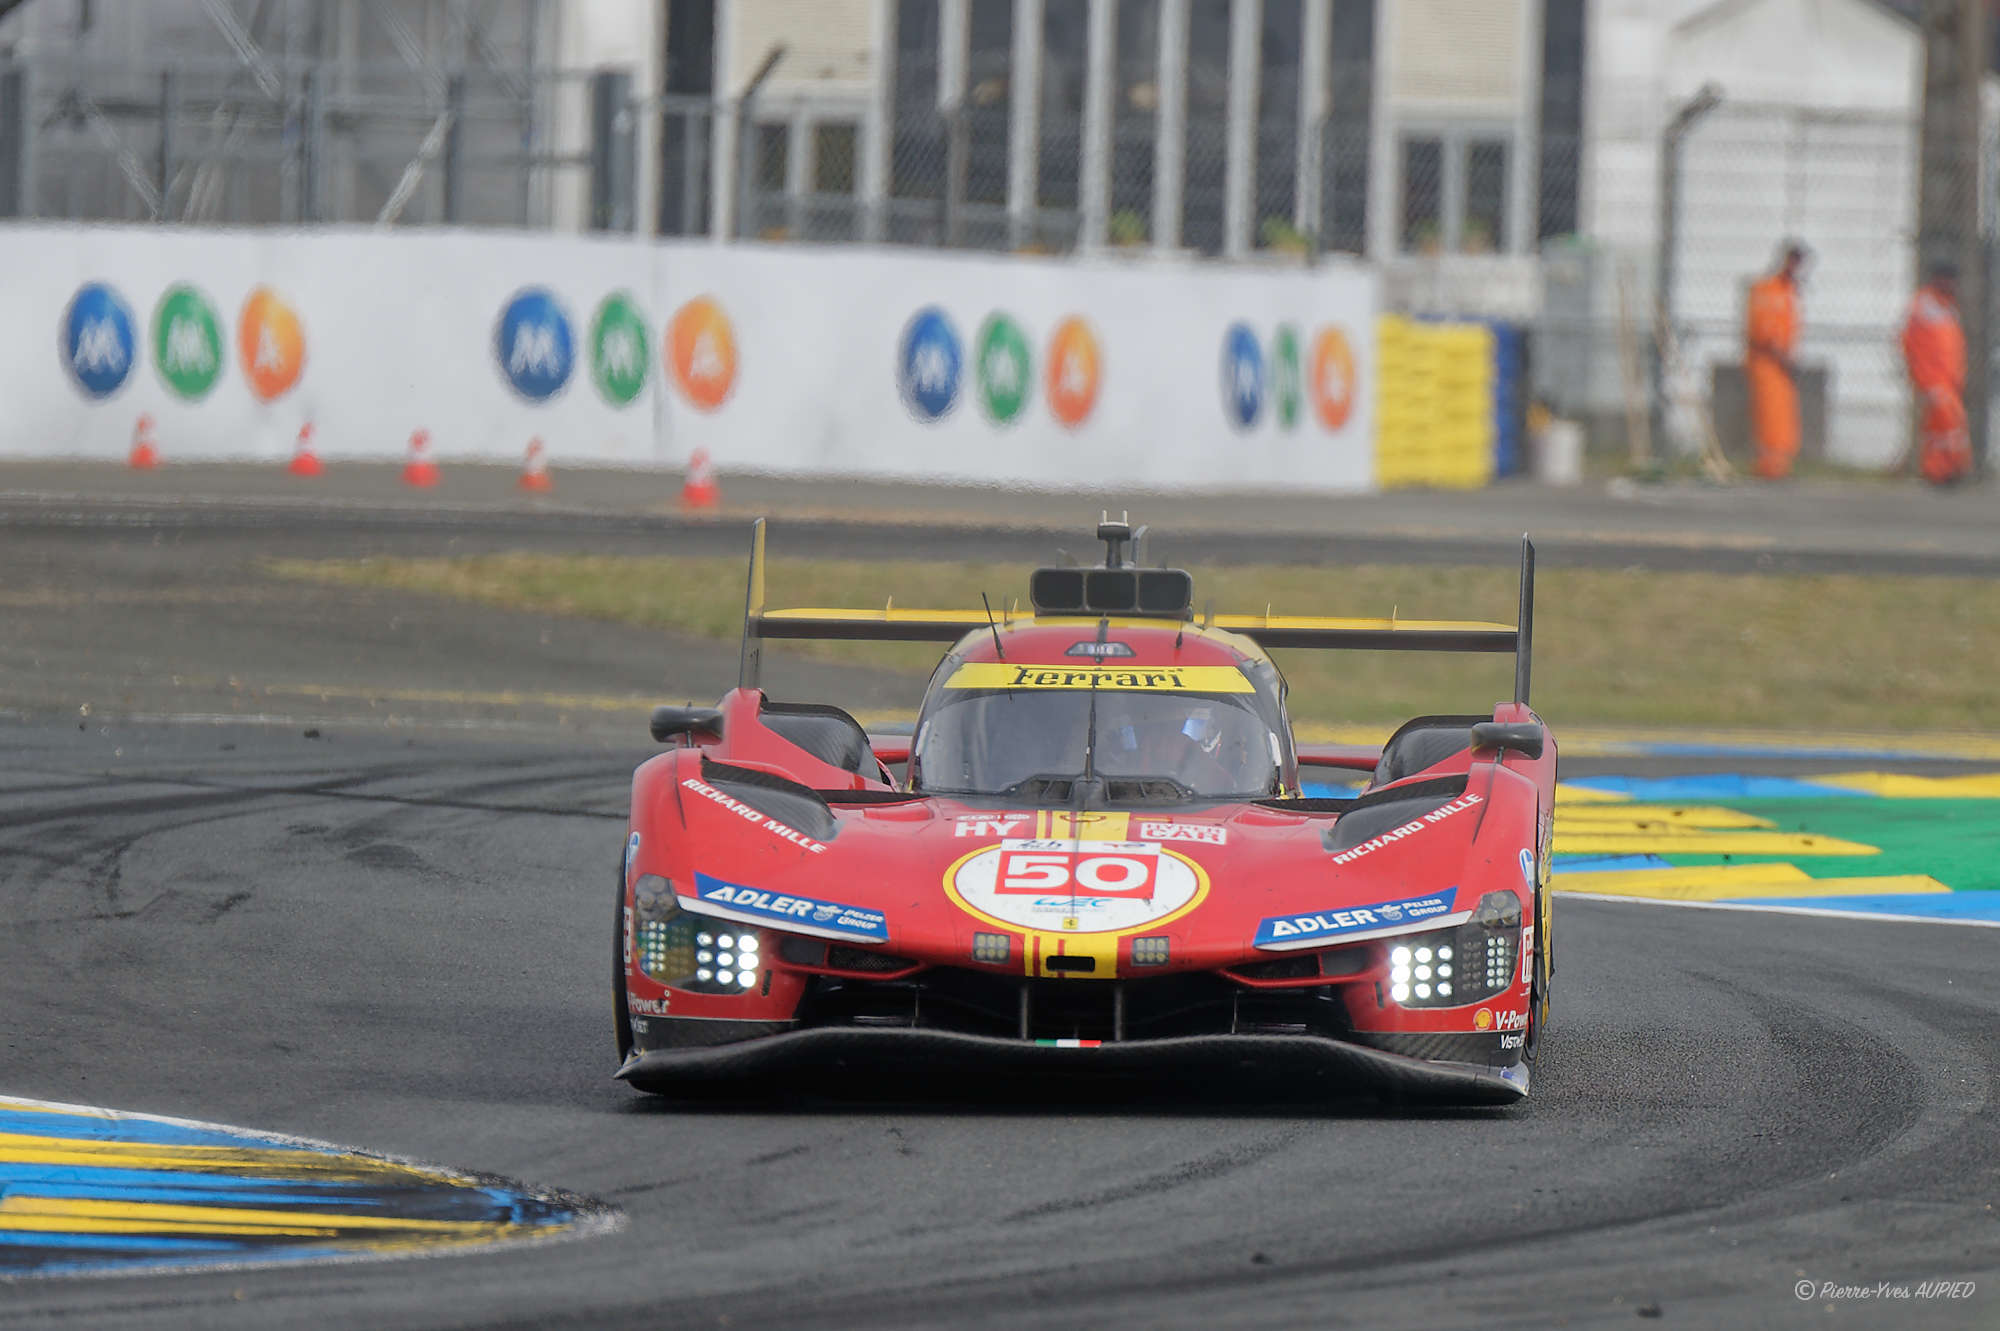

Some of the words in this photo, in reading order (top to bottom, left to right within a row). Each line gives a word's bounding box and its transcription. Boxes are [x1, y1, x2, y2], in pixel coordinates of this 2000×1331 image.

[1008, 666, 1185, 688] Ferrari
[681, 778, 763, 822] RICHARD
[763, 820, 827, 854] MILLE
[955, 822, 1020, 837] HY
[1332, 821, 1425, 865] RICHARD
[1424, 792, 1484, 824] MILLE
[1003, 855, 1149, 891] 50
[703, 886, 814, 917] ADLER
[1272, 909, 1379, 937] ADLER
